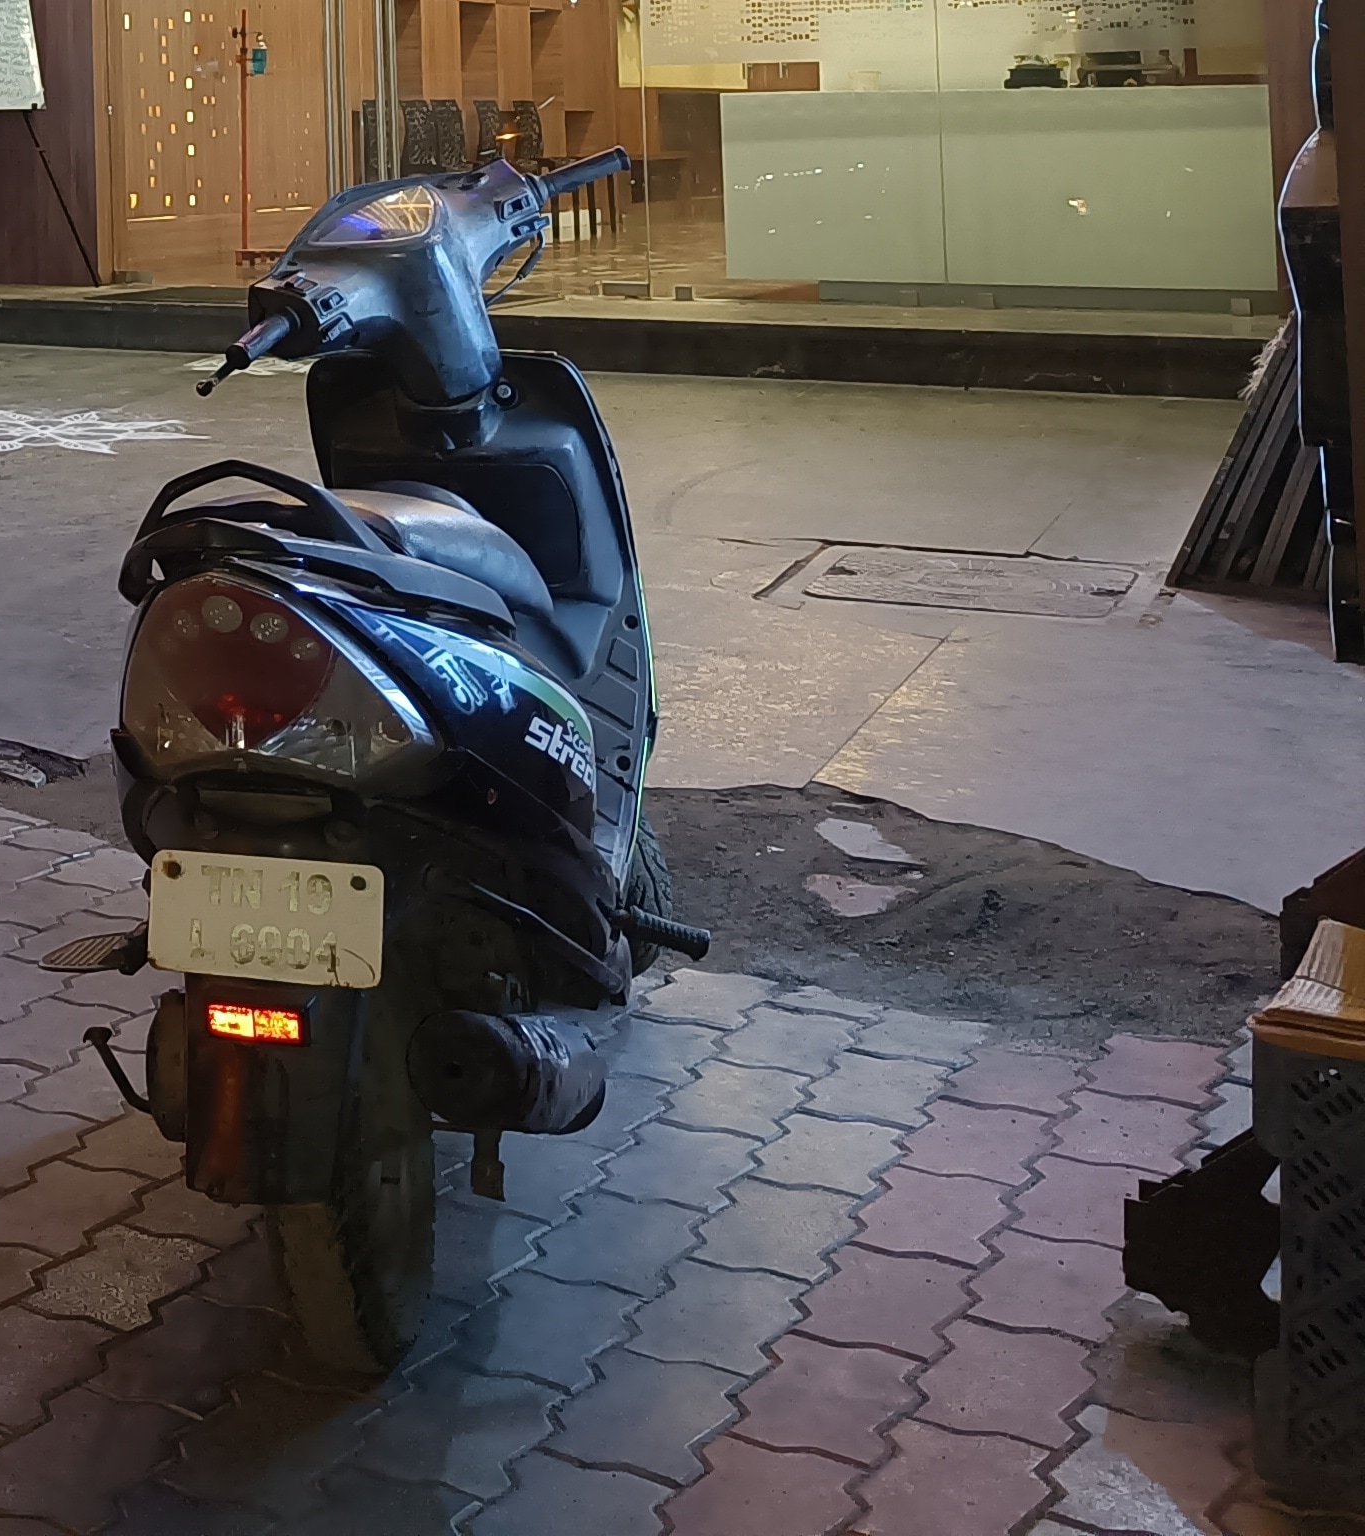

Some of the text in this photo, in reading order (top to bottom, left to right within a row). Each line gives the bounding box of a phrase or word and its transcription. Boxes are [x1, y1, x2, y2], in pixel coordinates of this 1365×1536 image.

[200, 864, 334, 916] TN 19
[189, 917, 341, 974] L 6904
